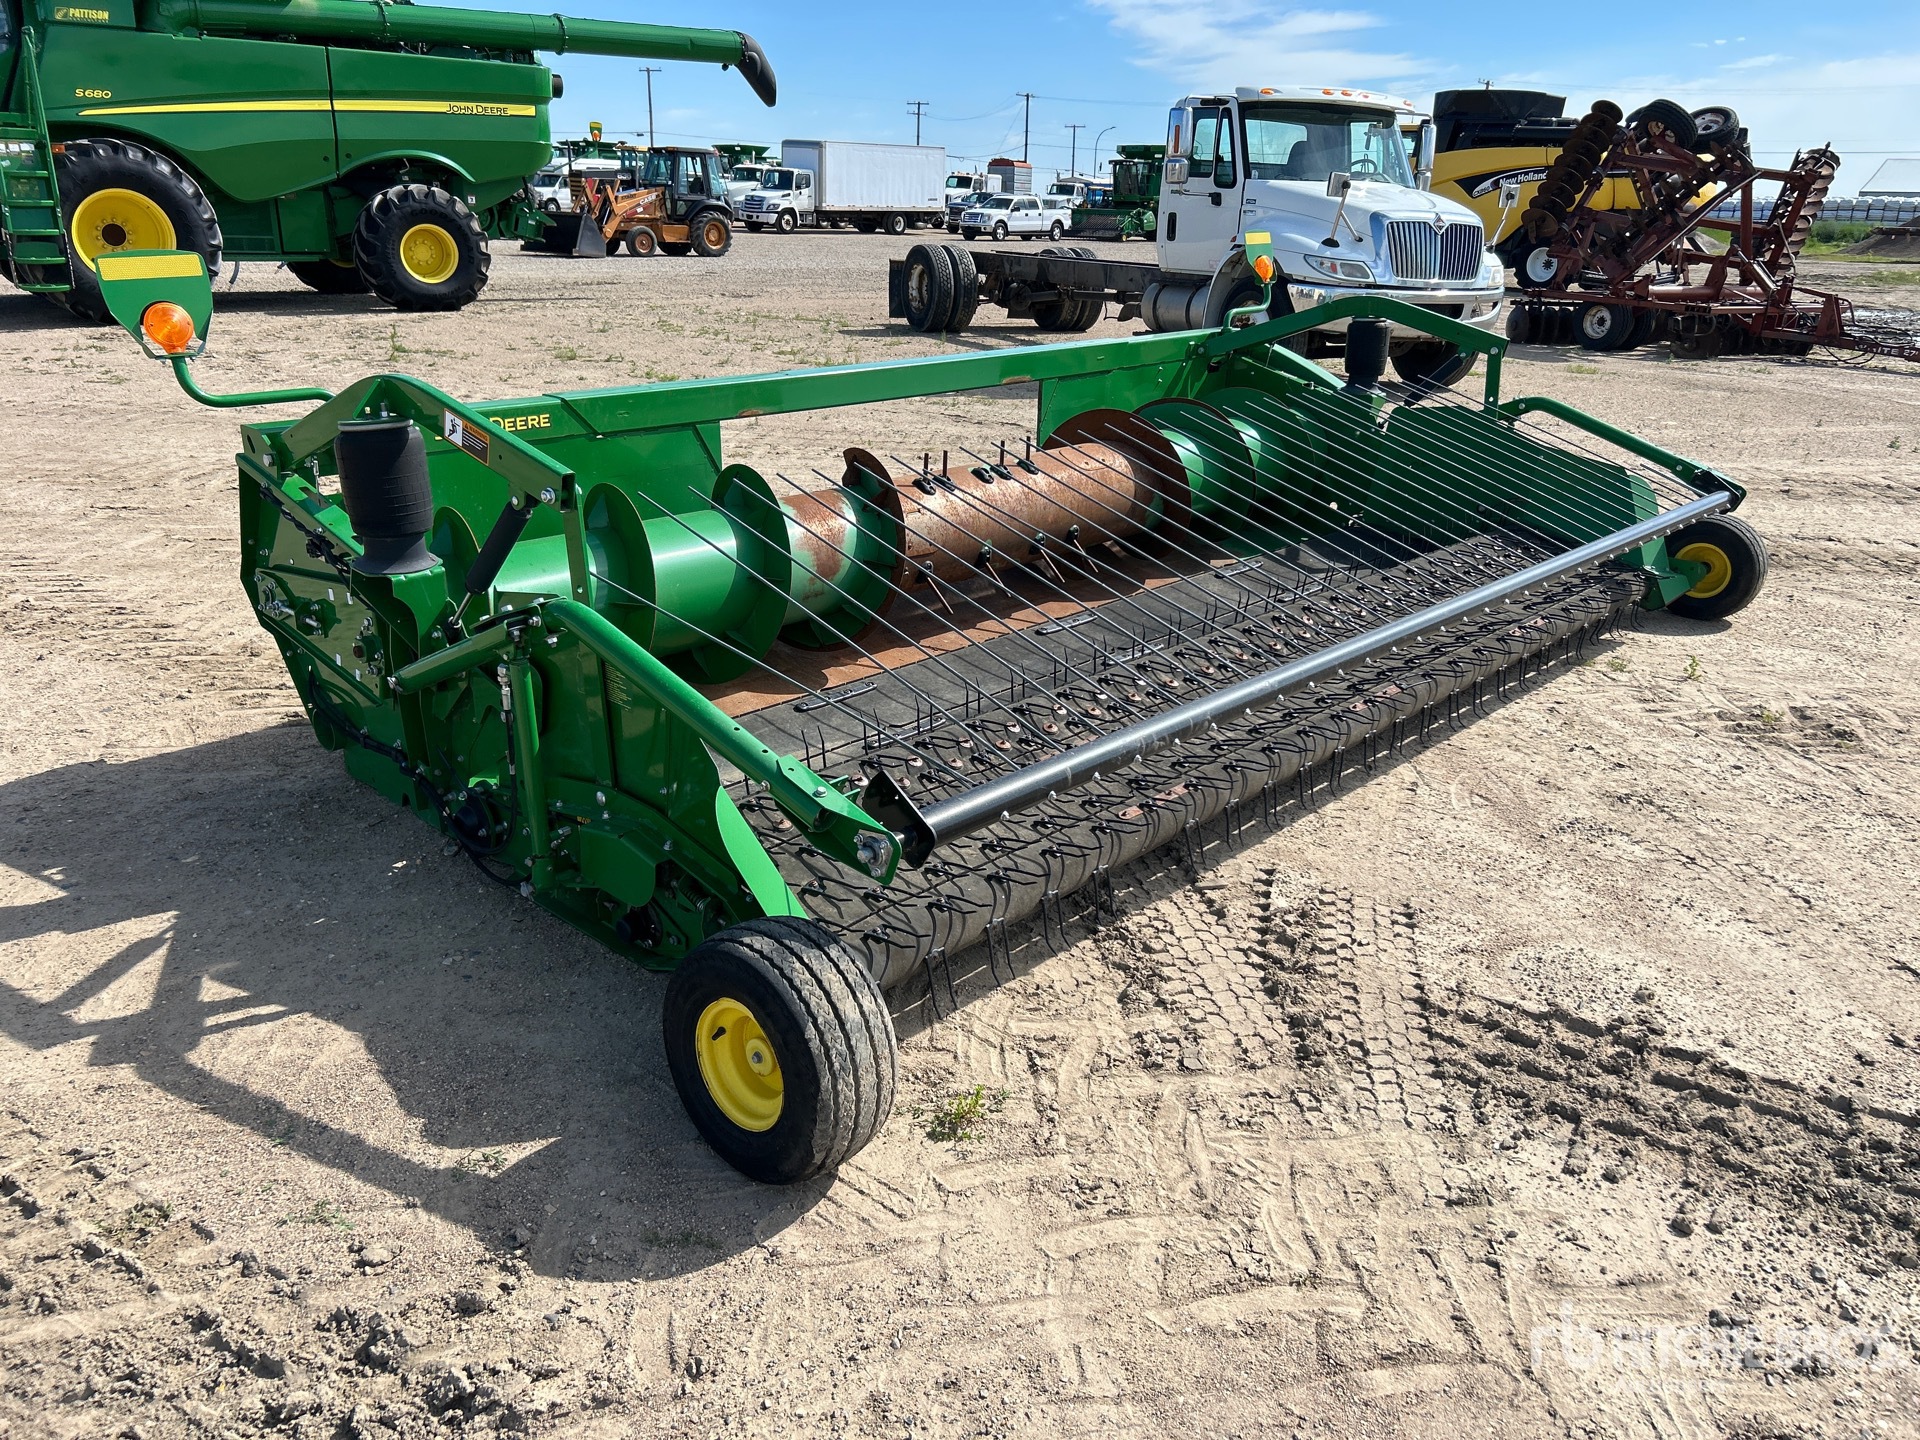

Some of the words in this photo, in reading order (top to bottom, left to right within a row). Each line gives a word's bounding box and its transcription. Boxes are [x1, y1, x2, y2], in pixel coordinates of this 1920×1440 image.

[69, 8, 109, 19] PATTISON
[75, 88, 112, 99] S680
[446, 104, 474, 113] JOHN
[475, 105, 509, 115] DEERE
[1499, 177, 1517, 188] New
[639, 193, 657, 205] CASE
[490, 414, 551, 432] DEERE
